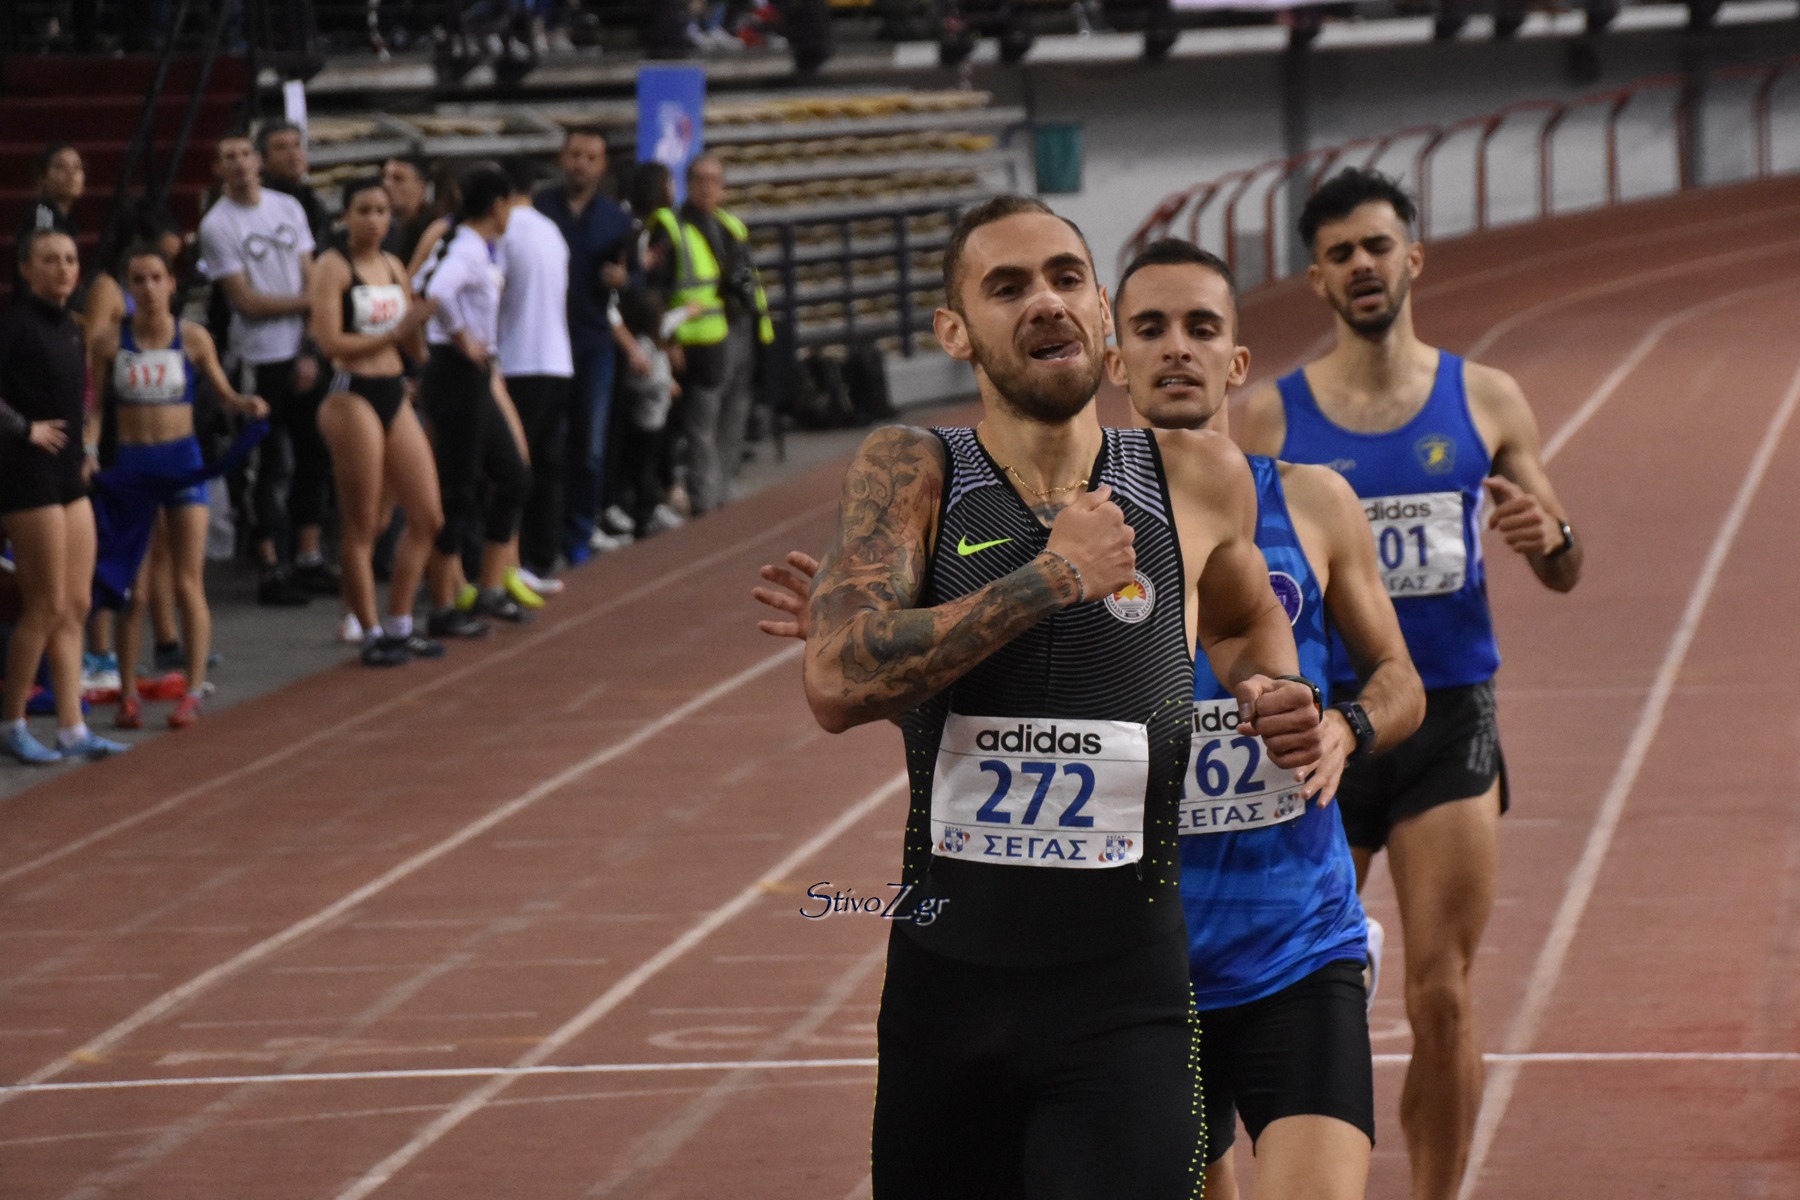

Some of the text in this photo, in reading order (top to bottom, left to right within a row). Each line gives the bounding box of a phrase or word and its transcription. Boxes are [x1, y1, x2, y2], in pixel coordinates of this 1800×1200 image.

[1363, 501, 1432, 521] didas
[1379, 525, 1428, 570] 01
[1389, 574, 1429, 591] ΓΑΣ
[975, 724, 1102, 755] adidas
[975, 759, 1096, 828] 272
[983, 834, 1088, 861] ΣΕΓΑΣ
